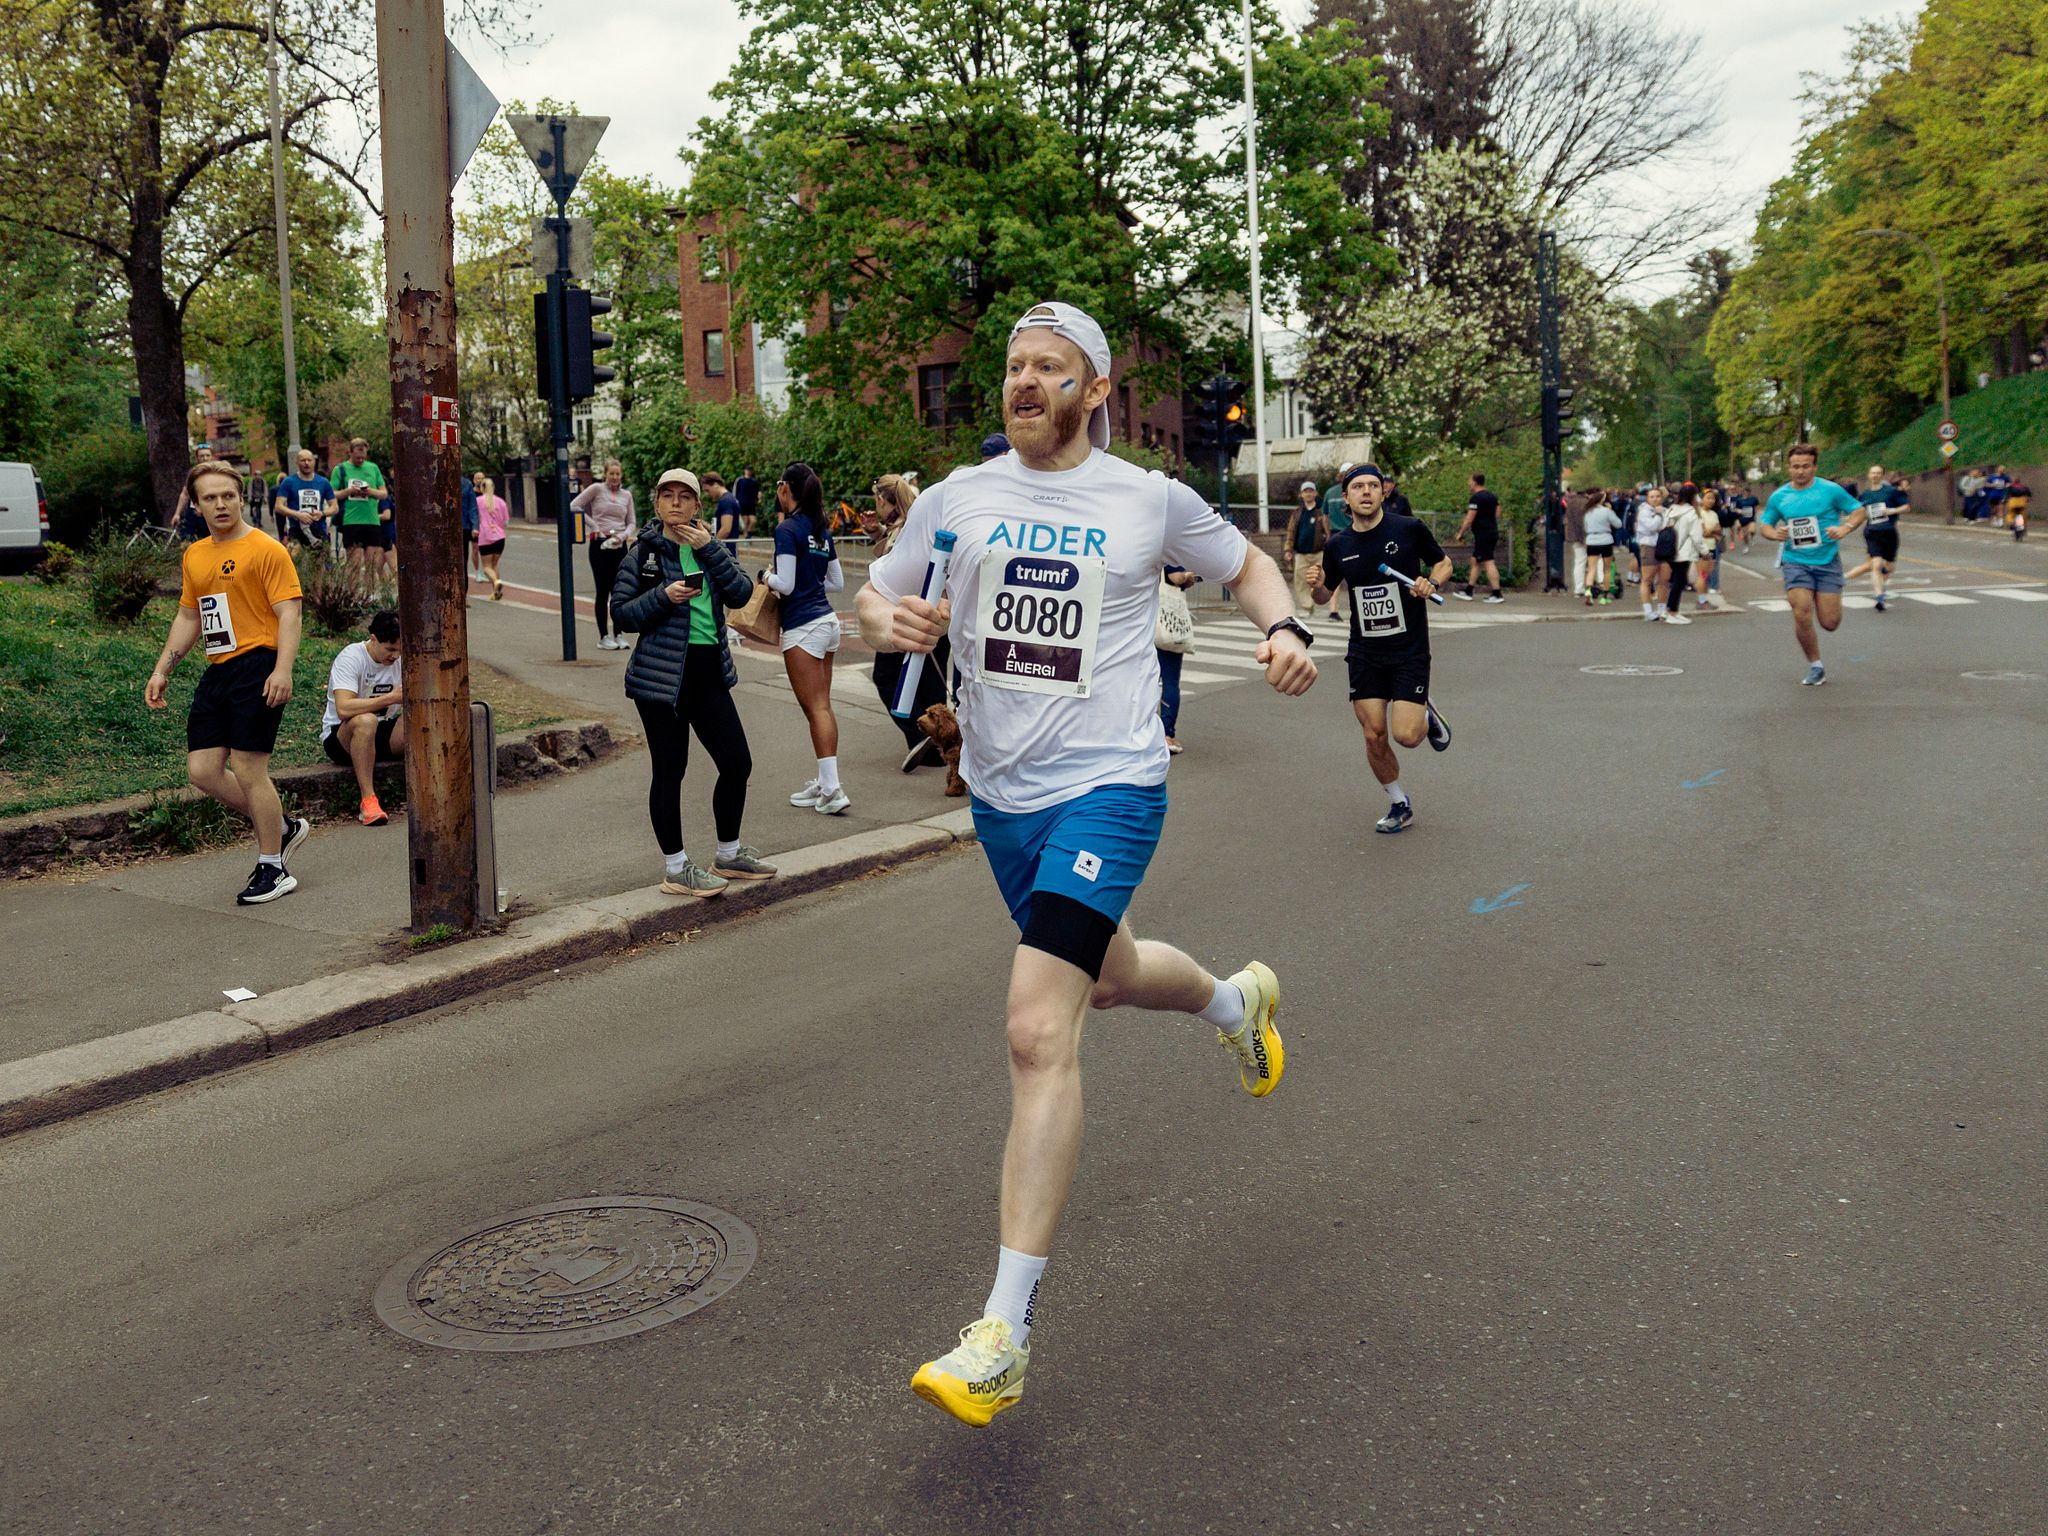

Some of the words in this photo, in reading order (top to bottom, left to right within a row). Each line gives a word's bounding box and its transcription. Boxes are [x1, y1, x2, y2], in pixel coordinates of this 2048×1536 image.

[1942, 426, 1955, 436] 40
[1033, 494, 1062, 502] CRAFT
[986, 521, 1106, 557] AIDER
[1792, 525, 1816, 537] 8030
[1015, 564, 1070, 585] trumf
[1364, 588, 1385, 598] trumf
[992, 591, 1083, 640] 8080
[1362, 599, 1396, 617] 8079
[1007, 643, 1017, 659] Å
[1005, 660, 1056, 677] ENERGI
[1252, 1028, 1269, 1079] BROOKS
[967, 1369, 1008, 1395] BROOKS
